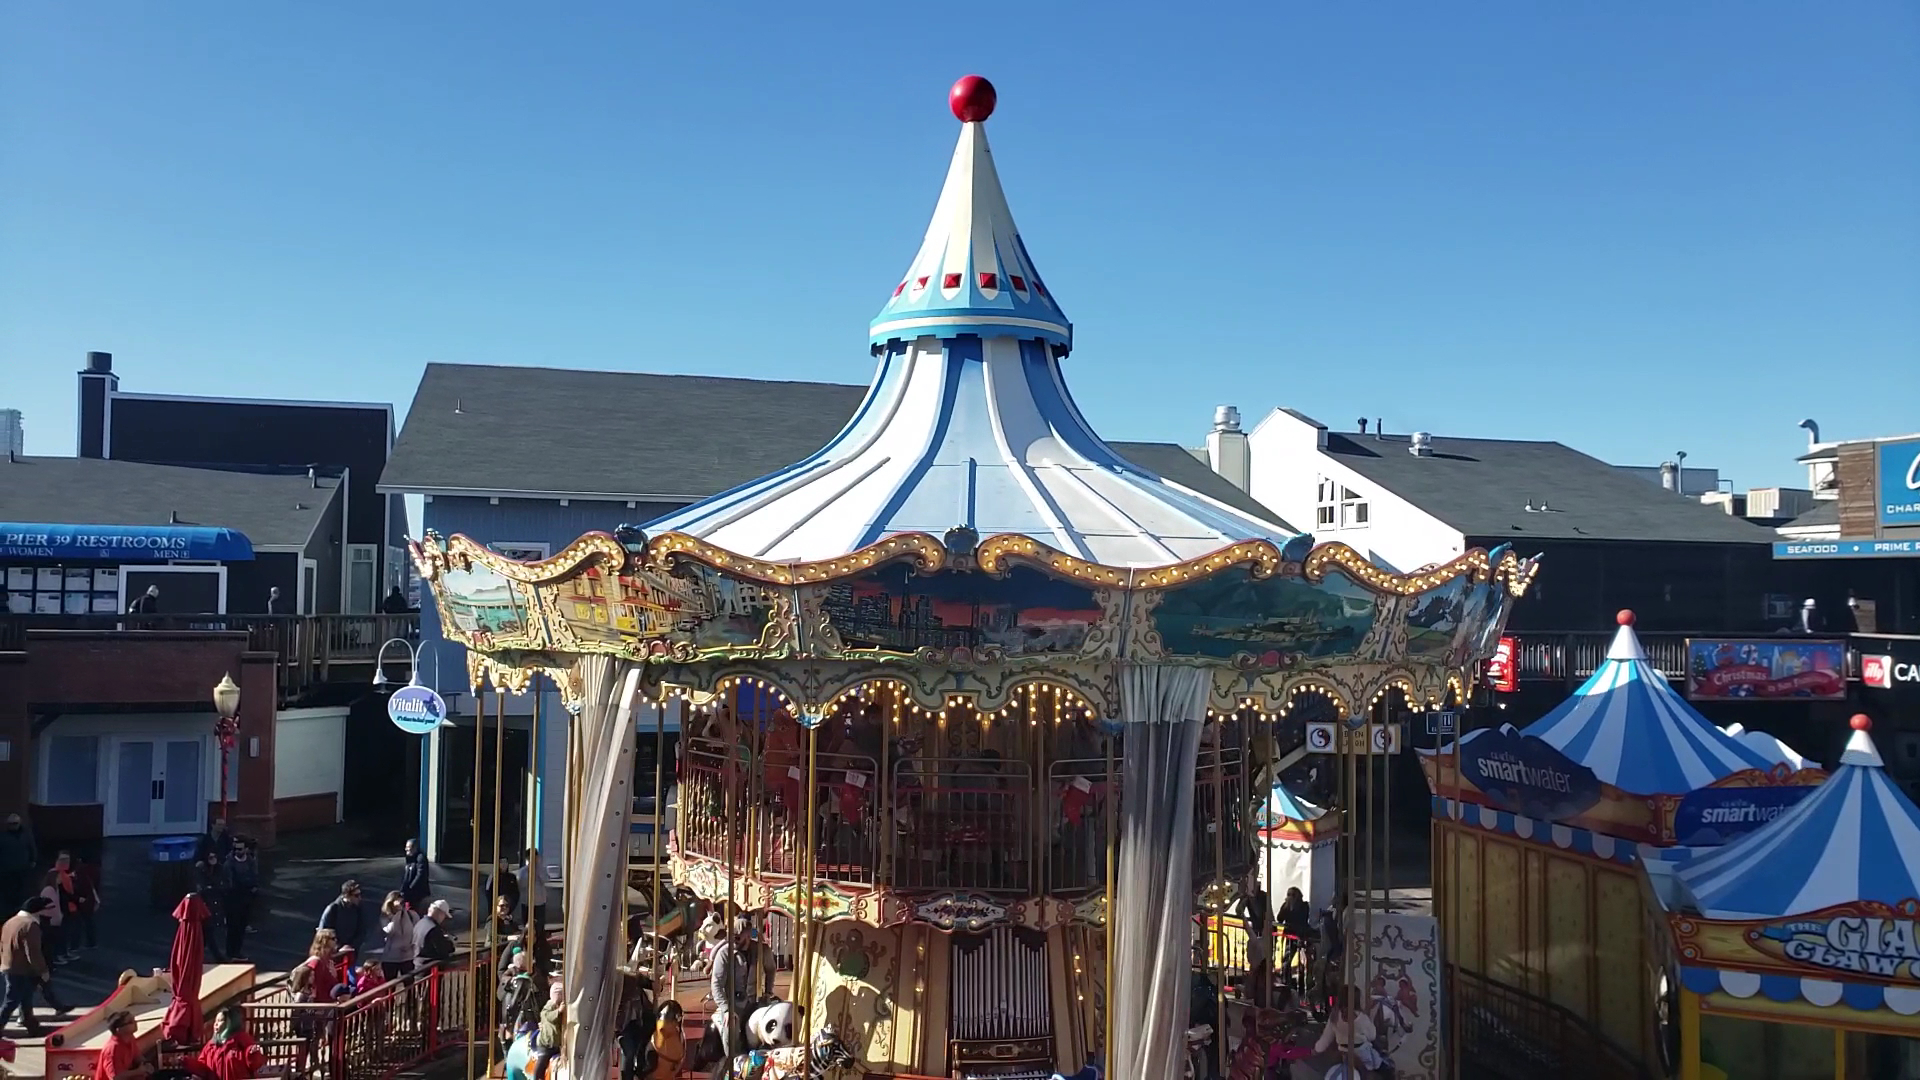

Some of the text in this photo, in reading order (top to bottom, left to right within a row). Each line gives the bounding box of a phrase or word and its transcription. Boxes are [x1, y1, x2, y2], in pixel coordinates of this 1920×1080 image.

[5, 533, 186, 549] PIER 39 RESTROOMS
[1787, 544, 1838, 554] SEAFOOD
[1874, 542, 1911, 552] PRIME
[8, 547, 54, 557] WOMEN
[154, 549, 179, 559] MEN
[1713, 669, 1767, 686] Christmas
[1894, 662, 1920, 682] CA
[1477, 757, 1571, 793] smartwater
[1701, 803, 1789, 823] smartwat
[1784, 940, 1903, 976] CLAW
